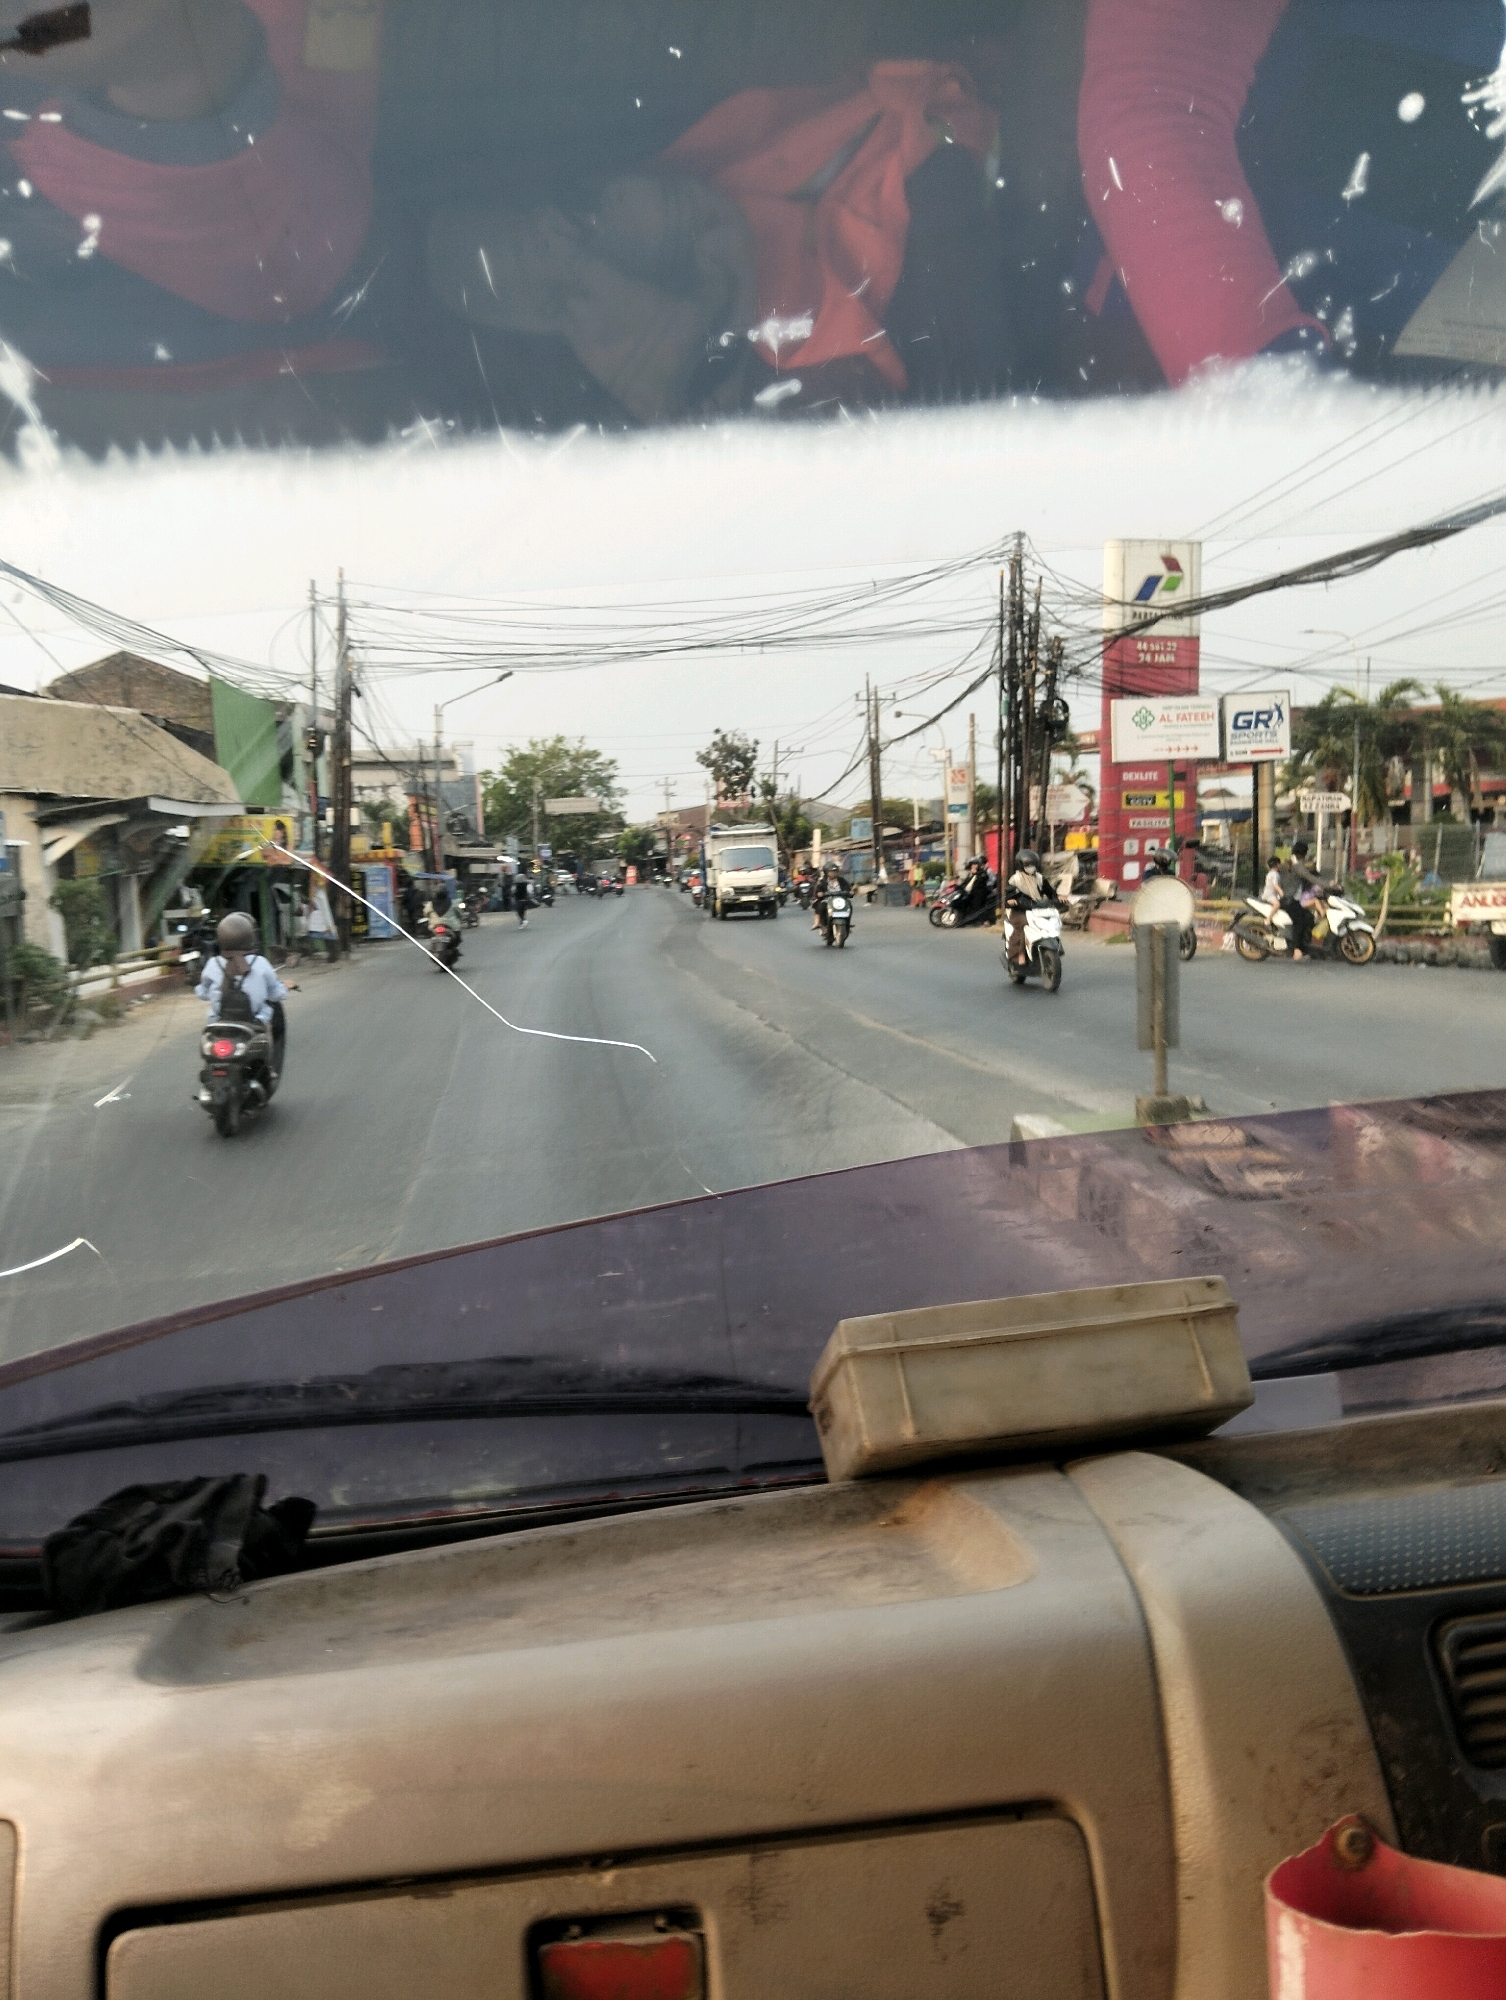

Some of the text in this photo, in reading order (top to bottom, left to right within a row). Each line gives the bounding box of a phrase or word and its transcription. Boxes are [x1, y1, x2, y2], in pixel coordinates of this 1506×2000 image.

[1158, 710, 1215, 723] AL FATEEH
[1231, 710, 1274, 730] GR
[1122, 772, 1157, 782] DEXLITE
[1131, 819, 1168, 827] FASILITA
